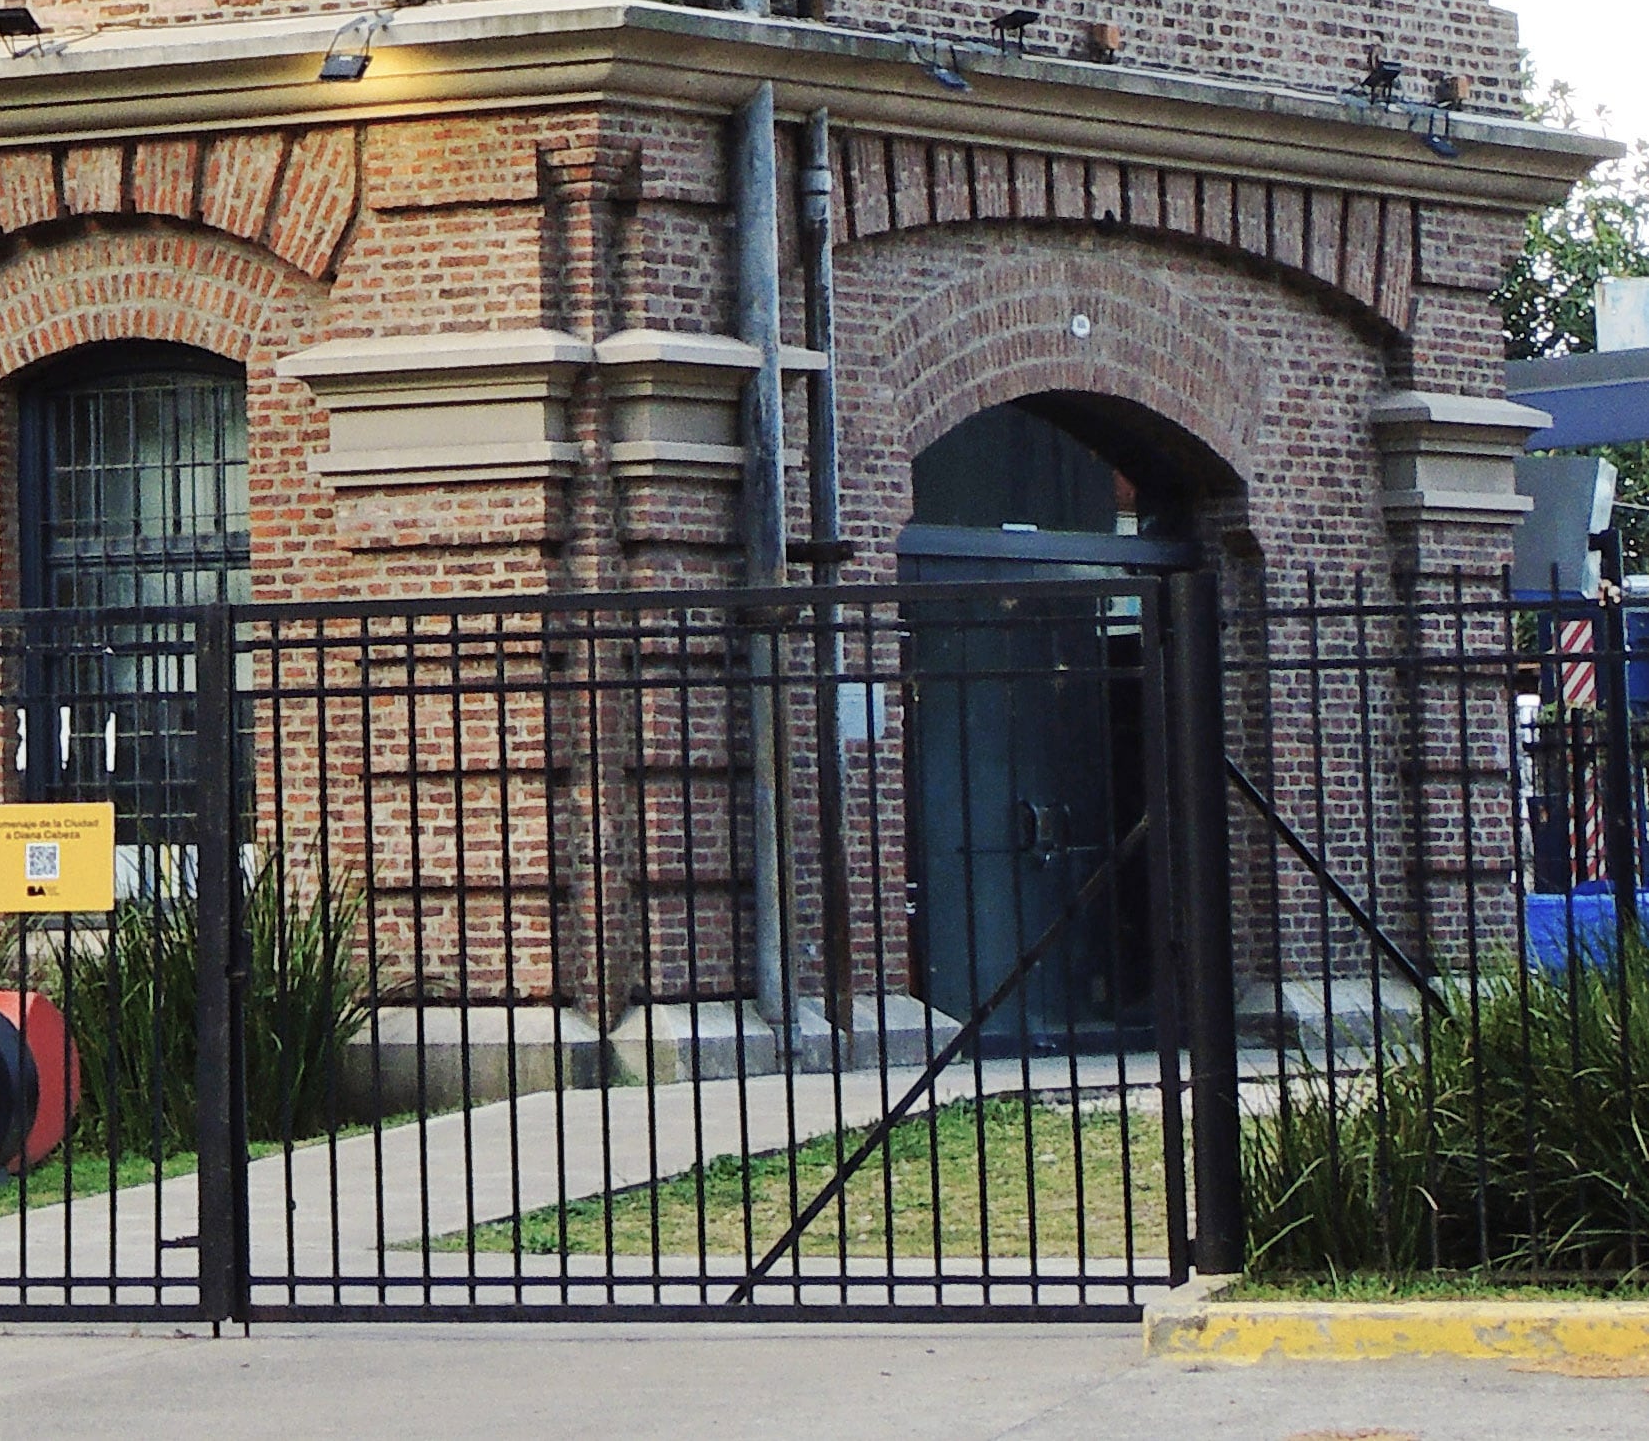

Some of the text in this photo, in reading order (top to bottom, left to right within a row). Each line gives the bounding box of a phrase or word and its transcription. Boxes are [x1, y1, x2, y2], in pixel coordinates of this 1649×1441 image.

[39, 820, 50, 828] de
[53, 819, 61, 828] la
[64, 819, 99, 828] Ciudad
[14, 831, 42, 840] Diana
[44, 830, 81, 839] Cabeza
